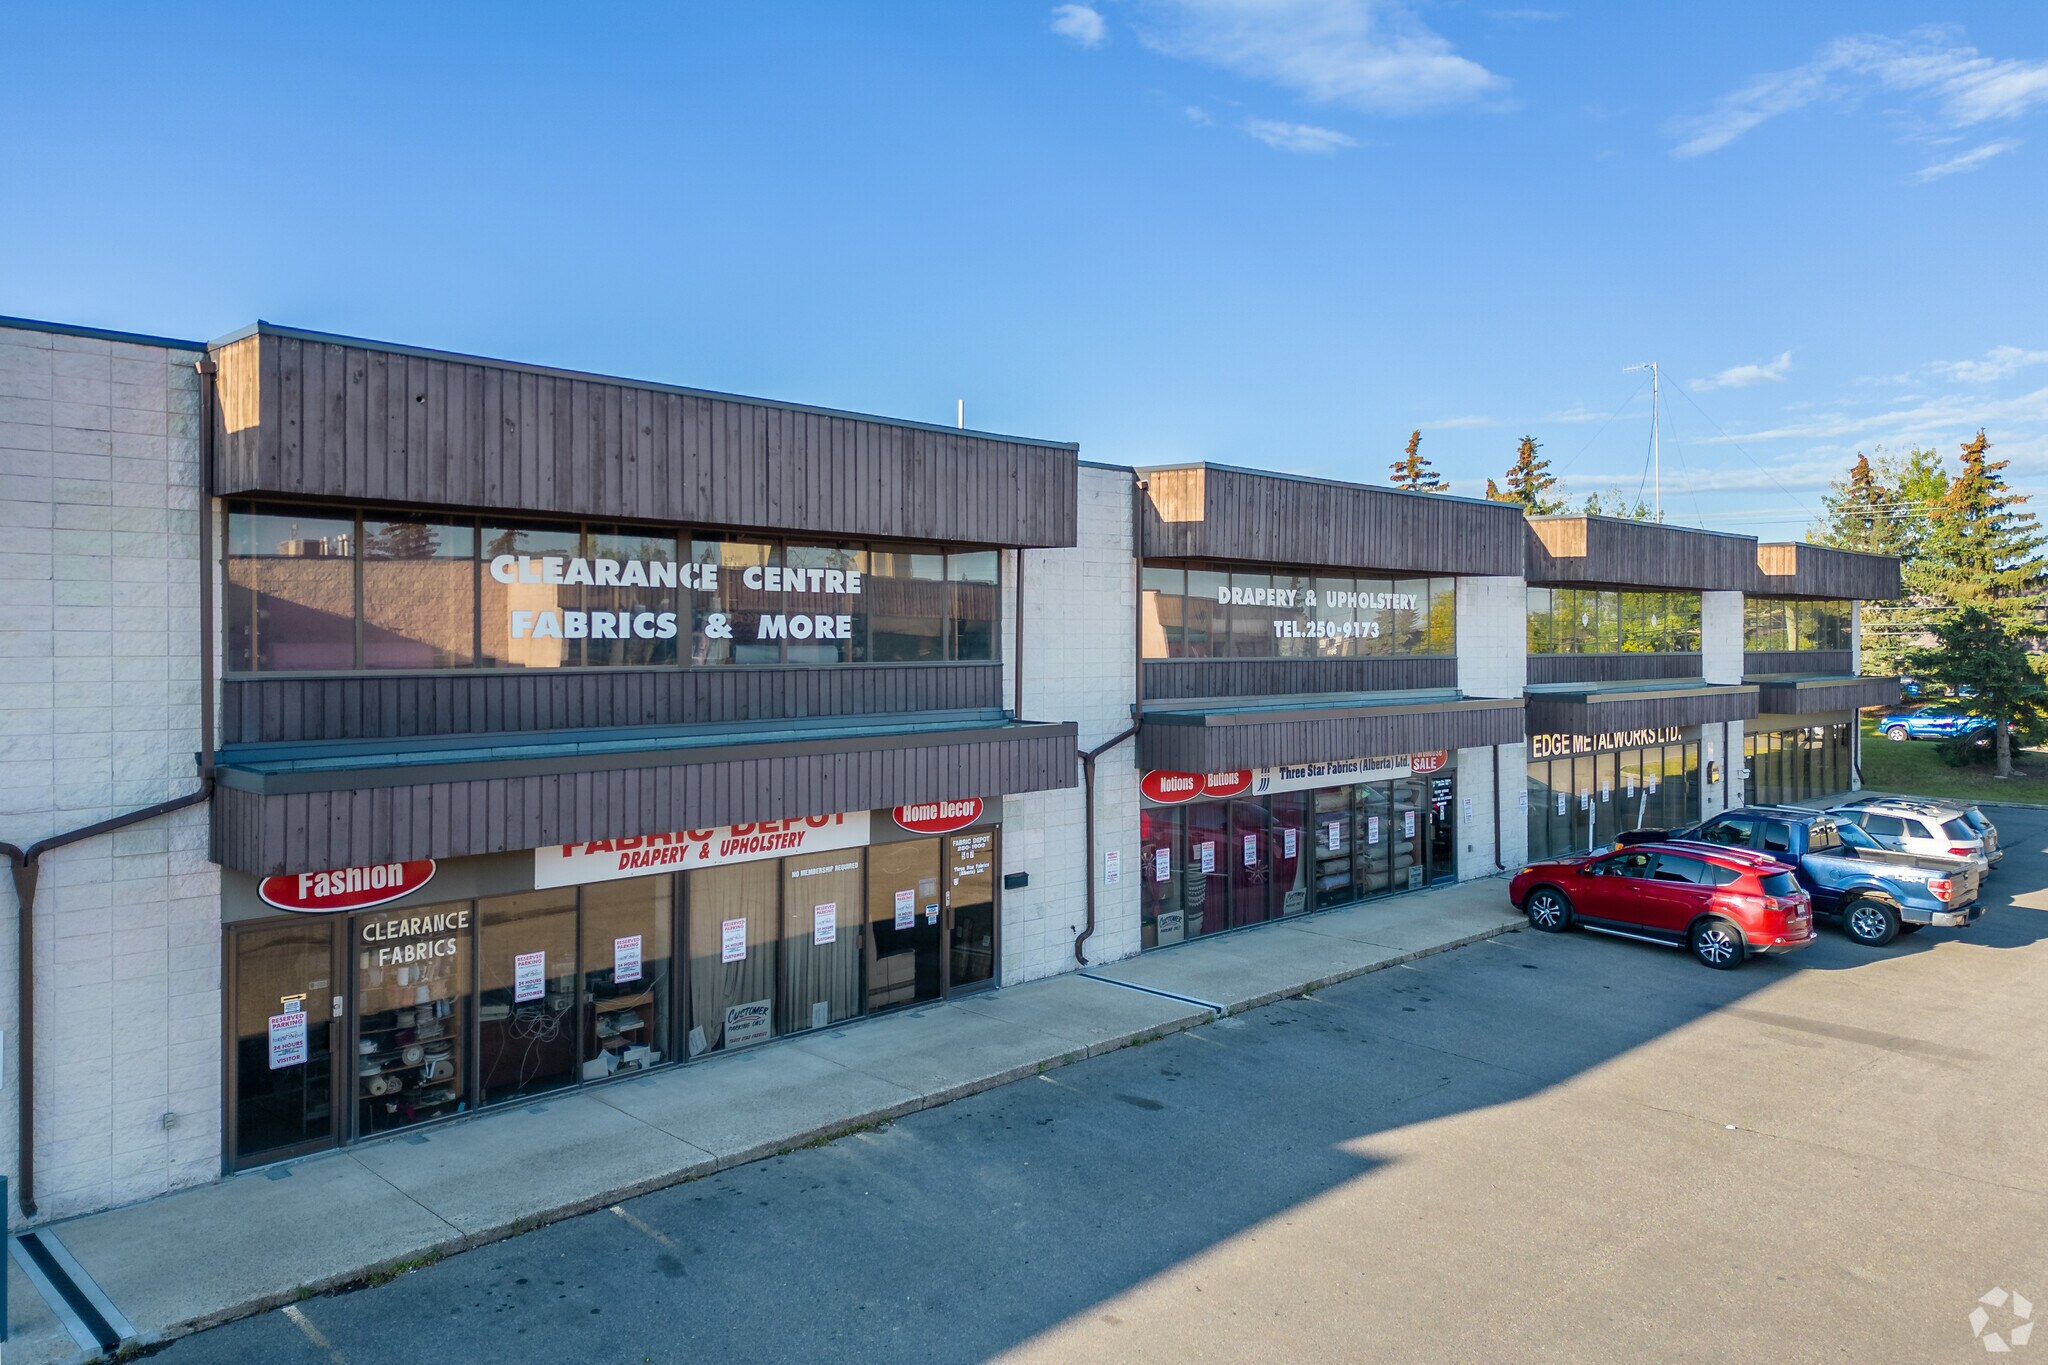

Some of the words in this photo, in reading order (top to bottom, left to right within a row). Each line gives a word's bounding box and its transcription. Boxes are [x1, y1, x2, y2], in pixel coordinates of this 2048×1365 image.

[490, 554, 718, 592] CLEARANCE
[742, 566, 862, 594] CENTRE
[1218, 586, 1297, 608] DRAPERY
[1305, 589, 1316, 607] &
[1326, 590, 1417, 610] UPHOLSTERY
[510, 610, 678, 640] FABRICS
[704, 612, 734, 640] &
[757, 614, 852, 640] MORE
[1533, 733, 1570, 758] EDGE
[1280, 766, 1305, 780] Three
[1307, 764, 1326, 777] Star
[1327, 760, 1358, 775] Fabrics
[1360, 756, 1394, 774] (Alberta)
[1395, 755, 1410, 768] Ltd.
[1413, 757, 1437, 771] SALE
[1160, 776, 1194, 793] Notions
[1207, 772, 1240, 788] Buttons
[902, 804, 938, 823] Home
[940, 801, 976, 819] Decor
[972, 836, 990, 844] DEPOT
[618, 844, 689, 871] DRAPERY
[698, 842, 710, 860] &
[720, 831, 806, 857] UPHOLSTERY
[800, 865, 834, 877] MEMBERSHIP
[834, 862, 859, 872] REQUIRED
[298, 863, 403, 900] Fashion
[362, 910, 469, 942] CLEARANCE
[378, 937, 457, 968] FABRICS
[517, 954, 543, 962] RESERVED
[517, 959, 542, 967] PARKING
[616, 972, 640, 980] CUSTOMER
[517, 990, 543, 998] CUSTOMER
[271, 1013, 304, 1024] RESERVED
[728, 1006, 769, 1024] CUSTOMER
[272, 1019, 303, 1029] PARKING
[282, 1040, 303, 1049] HOURS
[276, 1055, 301, 1064] VISITOR
